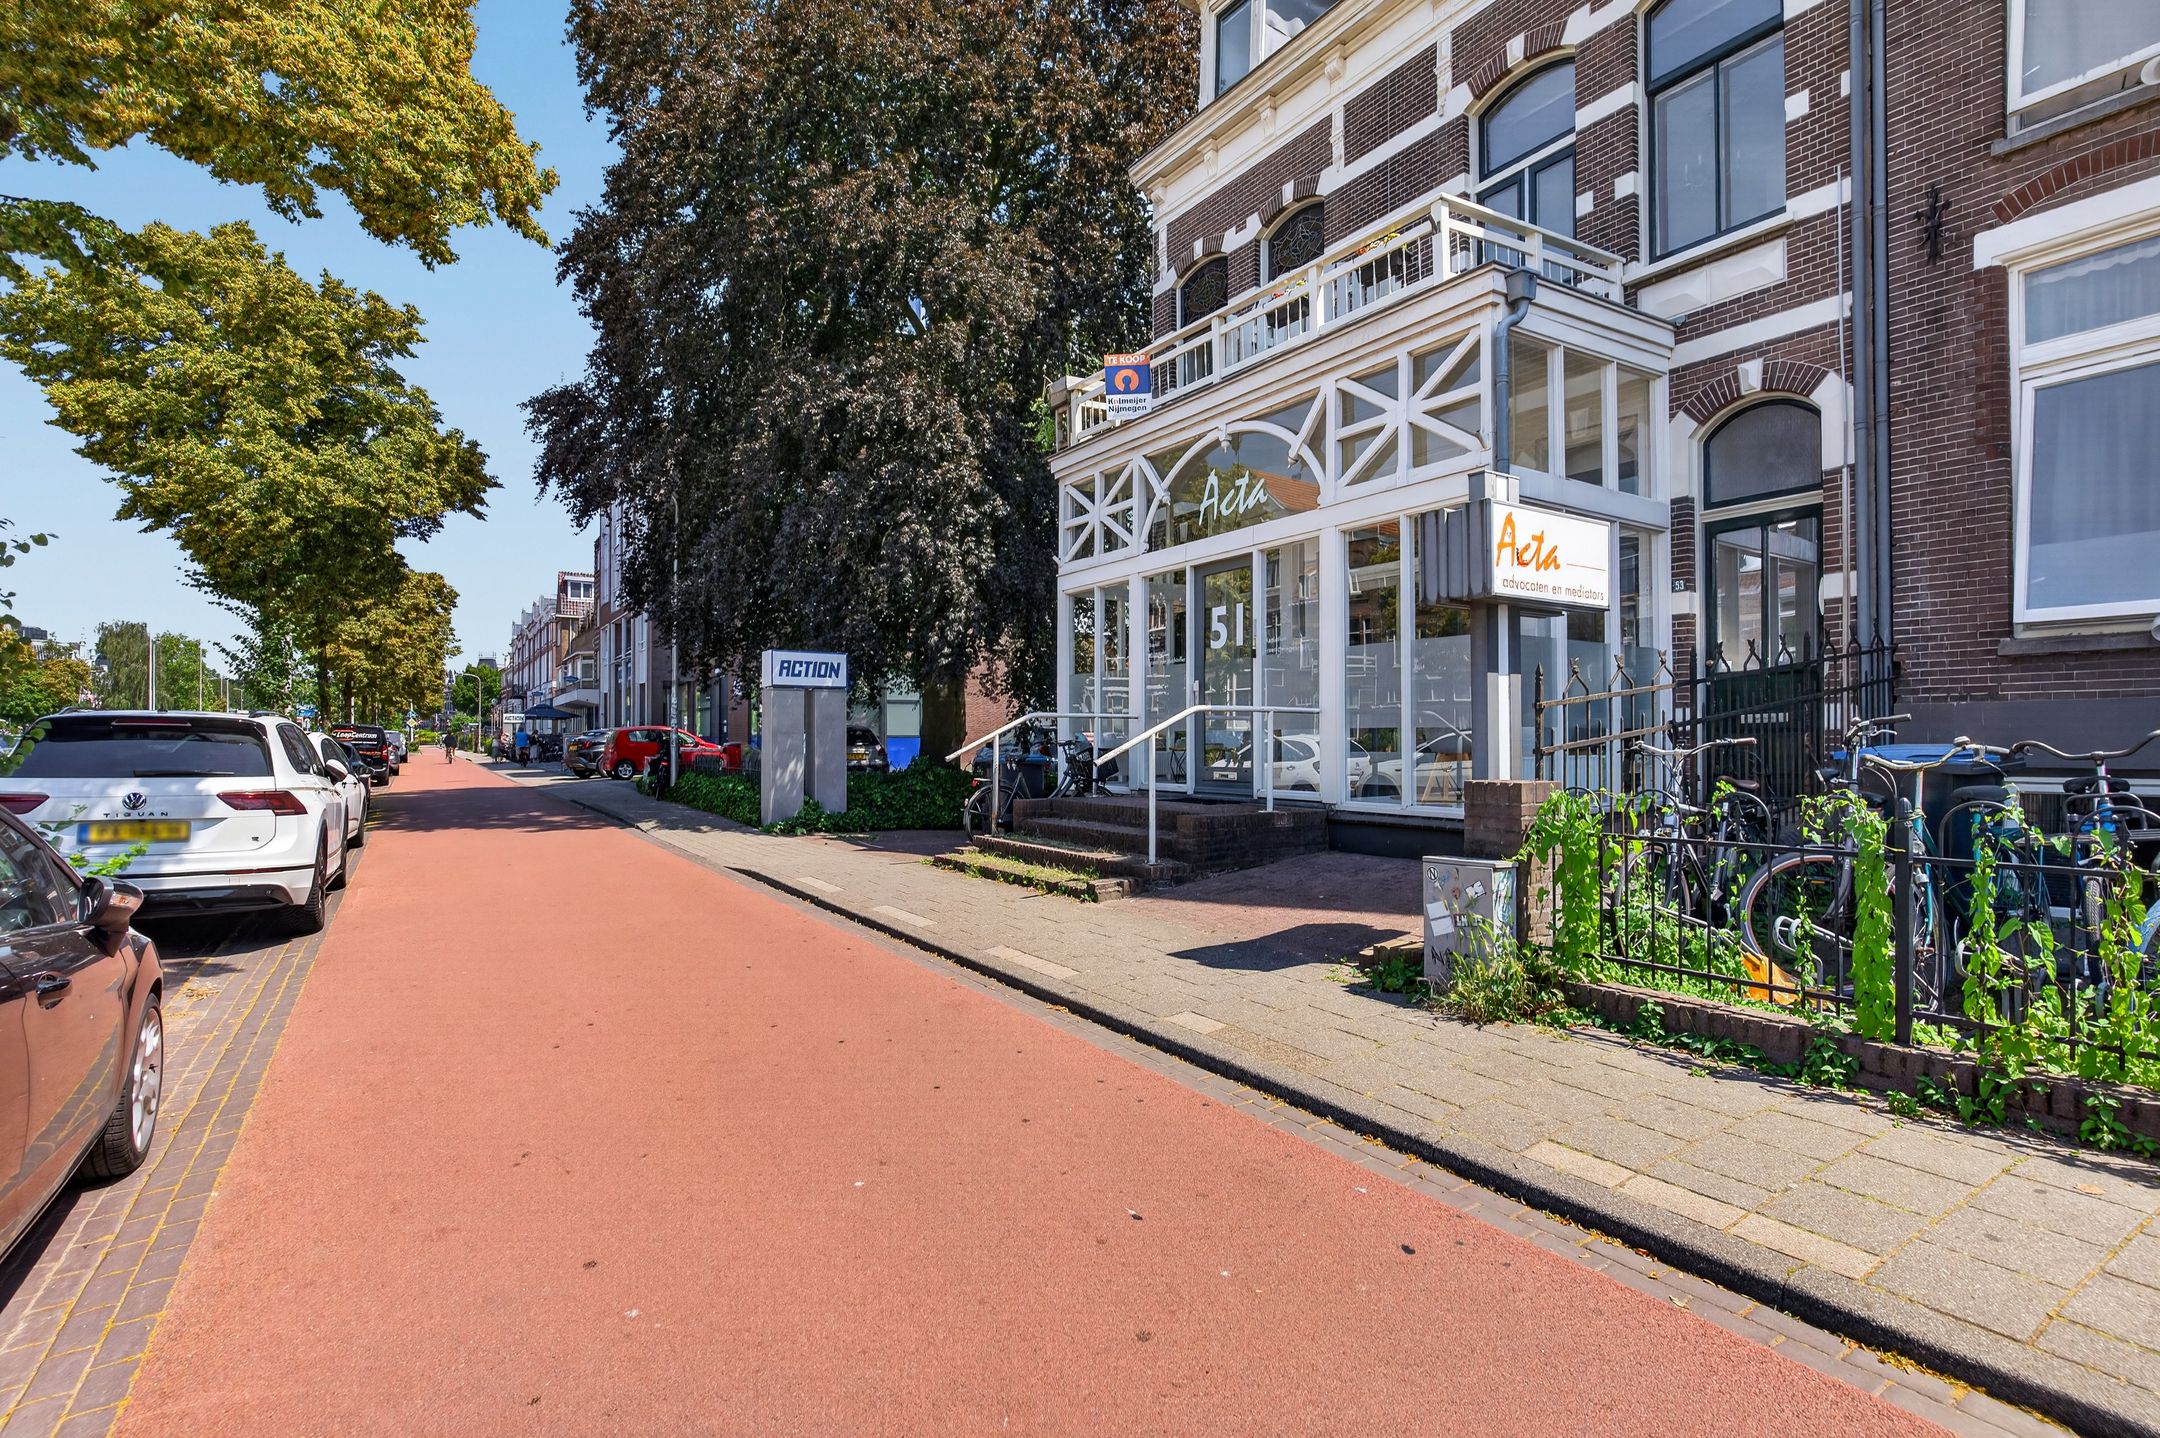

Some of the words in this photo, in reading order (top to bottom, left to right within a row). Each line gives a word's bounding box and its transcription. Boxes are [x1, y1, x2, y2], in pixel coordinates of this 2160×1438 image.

[1108, 356, 1118, 364] TE
[1120, 354, 1146, 364] KOOP
[1108, 405, 1147, 413] Nijmegen
[1199, 468, 1269, 526] Acta
[1496, 511, 1561, 572] Acta
[1502, 574, 1549, 593] advocaten
[1552, 585, 1562, 594] en
[1565, 584, 1604, 601] mediators
[1675, 580, 1684, 591] 53
[1211, 602, 1244, 649] 51
[778, 659, 841, 679] ACTION
[336, 731, 378, 739] LoopCentrum
